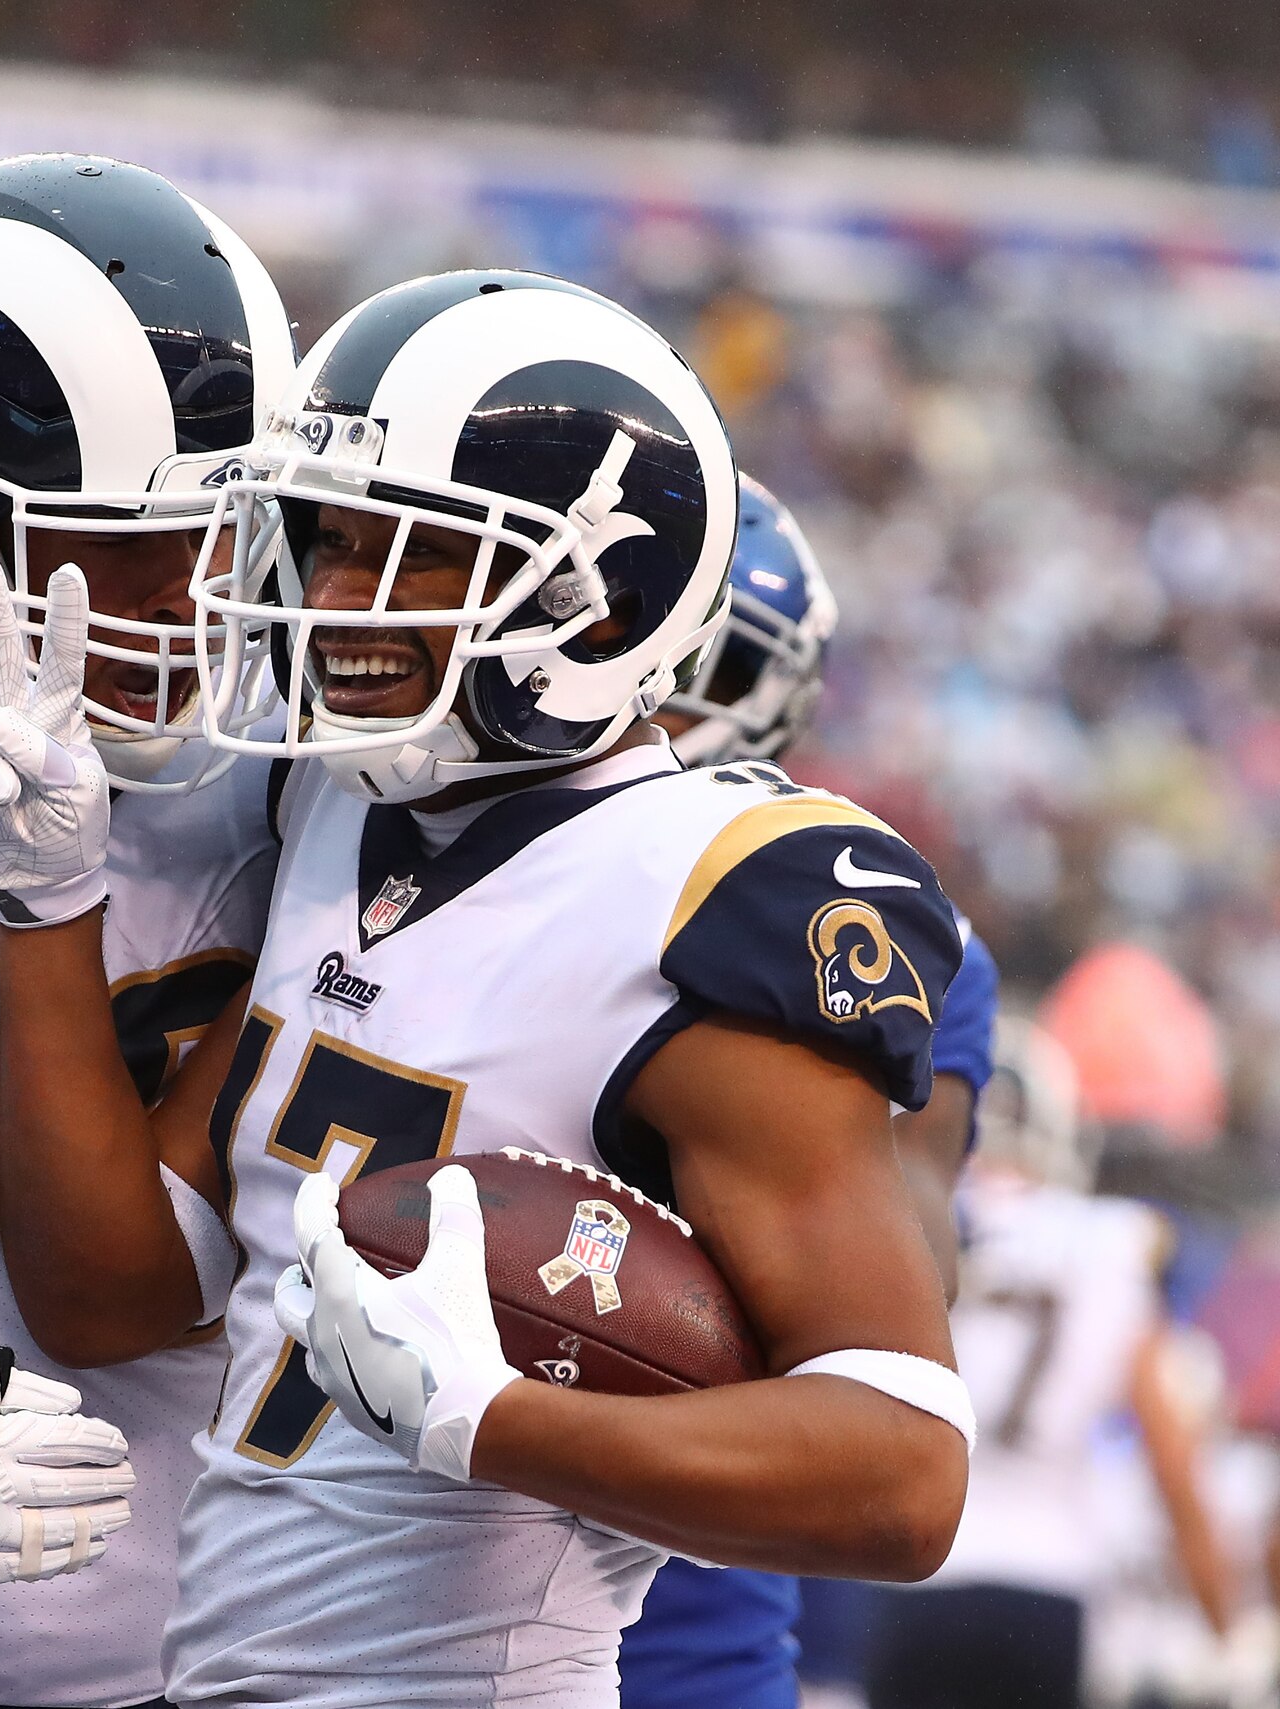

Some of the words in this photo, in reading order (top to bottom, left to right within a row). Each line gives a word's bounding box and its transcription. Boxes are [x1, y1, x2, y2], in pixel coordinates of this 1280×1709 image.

[368, 899, 399, 927] NFL
[311, 951, 382, 1010] Rams
[572, 1235, 612, 1270] NFL
